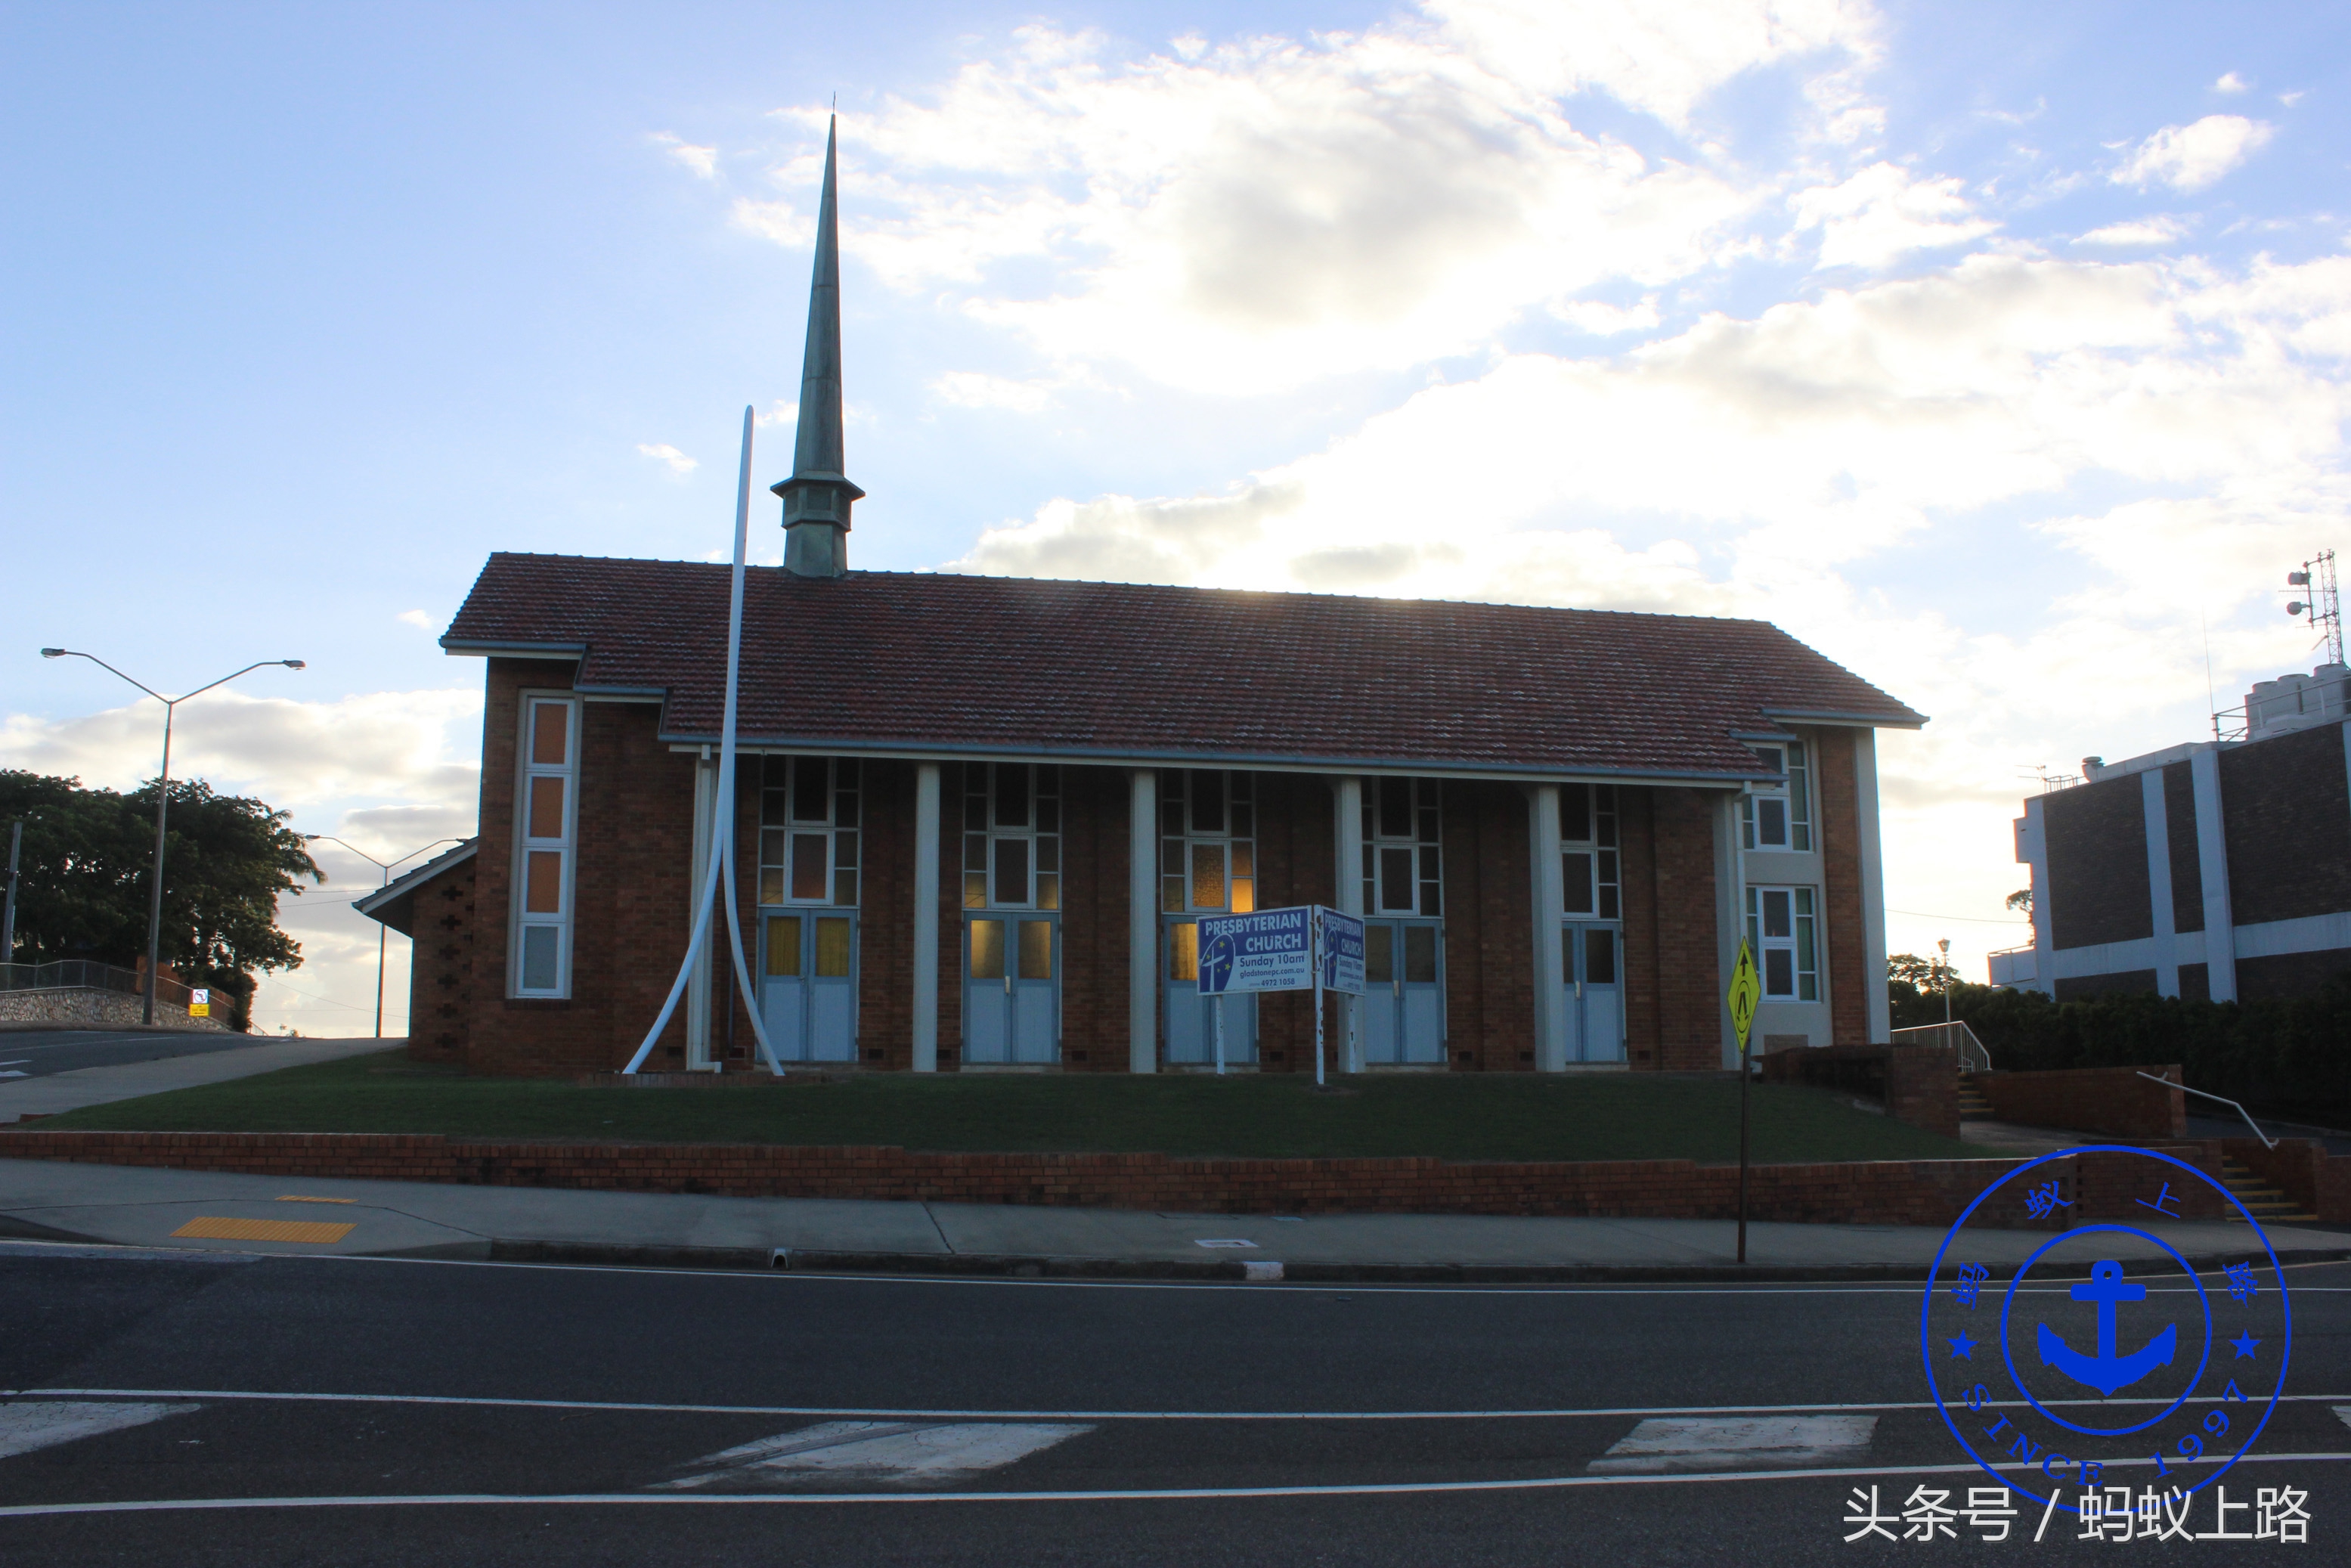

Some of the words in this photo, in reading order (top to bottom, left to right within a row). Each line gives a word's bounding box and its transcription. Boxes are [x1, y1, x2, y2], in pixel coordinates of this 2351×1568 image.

[1205, 913, 1301, 936] PRESBYTERIAN
[1324, 913, 1361, 937] PRESBYTERIAN
[1245, 933, 1302, 953] CHURCH
[1341, 937, 1361, 956] CHURCH
[1240, 956, 1275, 968] Sunday
[1278, 954, 1305, 965] 10am
[1240, 967, 1305, 979] gladstonepc.com.au
[1279, 978, 1295, 986] 1058
